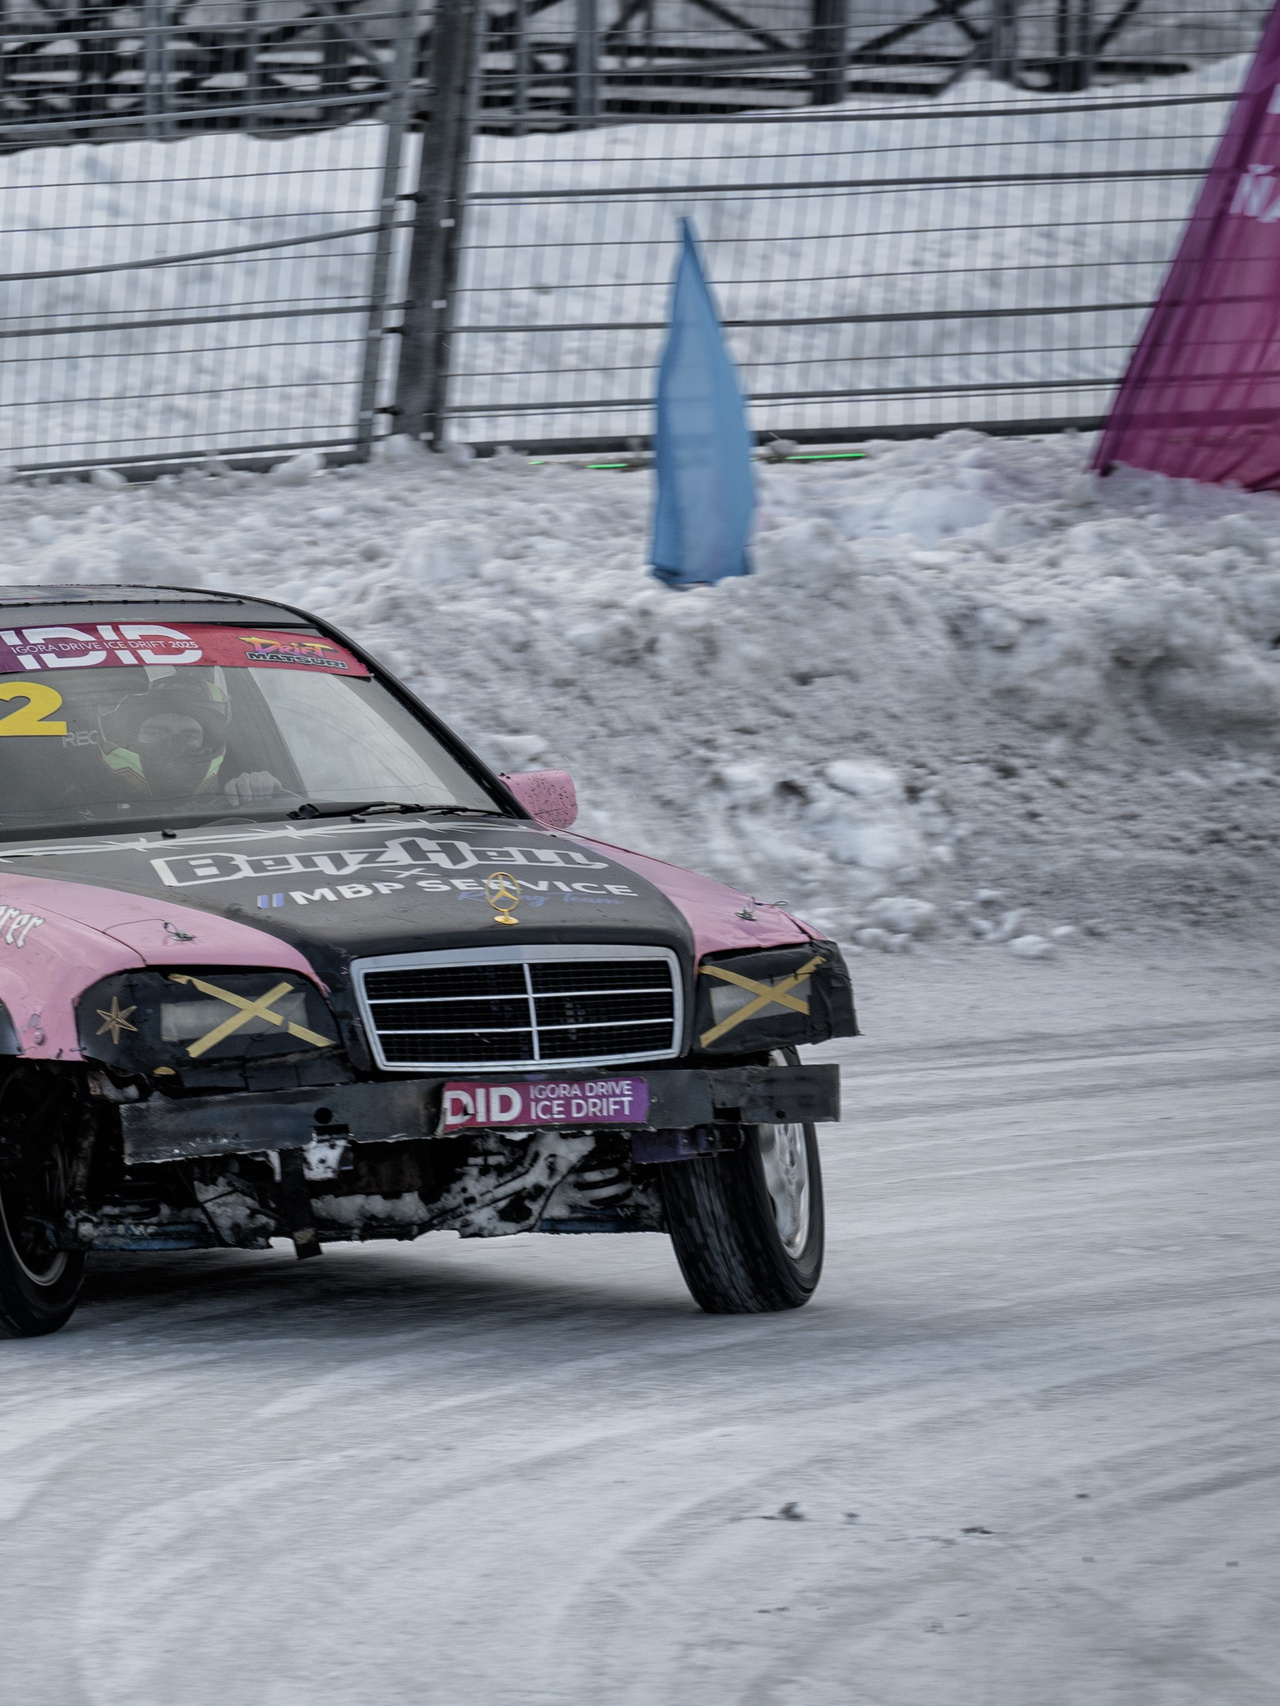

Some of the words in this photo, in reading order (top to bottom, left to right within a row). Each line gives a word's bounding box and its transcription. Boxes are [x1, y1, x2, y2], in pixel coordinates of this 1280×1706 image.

[11, 642, 57, 654] IGORA
[59, 641, 102, 652] DRIVE
[104, 641, 127, 650] ICE
[129, 639, 166, 650] DRIFT
[168, 640, 200, 650] 2025
[245, 651, 349, 670] MATSURI
[415, 879, 639, 897] SERVICE
[530, 1083, 582, 1099] IGORA
[584, 1080, 634, 1097] DRIVE
[530, 1100, 566, 1120] ICE
[571, 1097, 634, 1119] DRIFT
